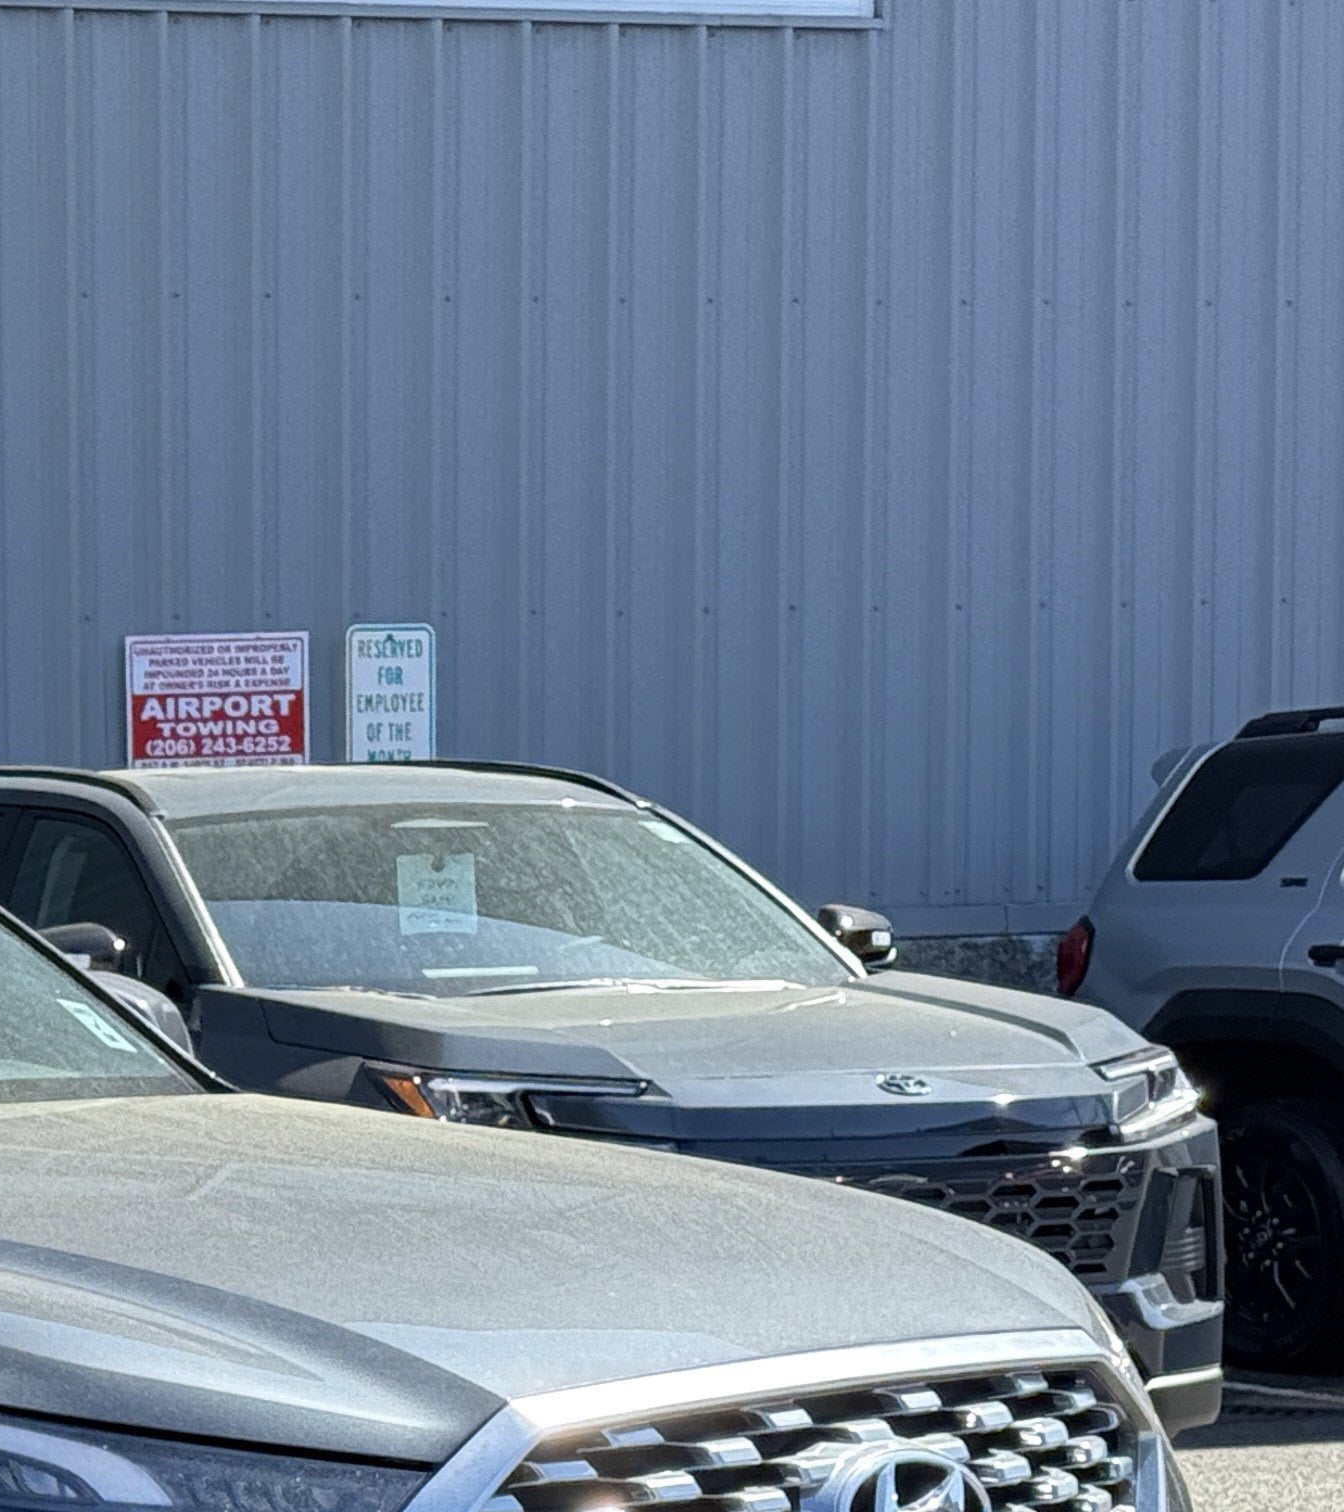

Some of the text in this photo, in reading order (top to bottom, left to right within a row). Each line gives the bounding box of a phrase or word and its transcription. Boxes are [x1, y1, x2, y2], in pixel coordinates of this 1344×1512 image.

[358, 638, 423, 658] RESERVED
[148, 655, 285, 667] PARKED VEHICLES WILL BE
[144, 668, 204, 679] IMPOUNDED
[221, 667, 257, 677] HOURS
[260, 667, 267, 676] A
[270, 666, 290, 675] DAY
[378, 666, 403, 685] FOR
[143, 681, 156, 691] AT
[207, 679, 231, 689] RISK
[141, 694, 296, 721] AIRPORT
[357, 692, 424, 713] EMPLOYEE
[156, 719, 280, 737] TOWING
[366, 722, 412, 742] OF THE
[145, 735, 291, 756] (206) 243-6252
